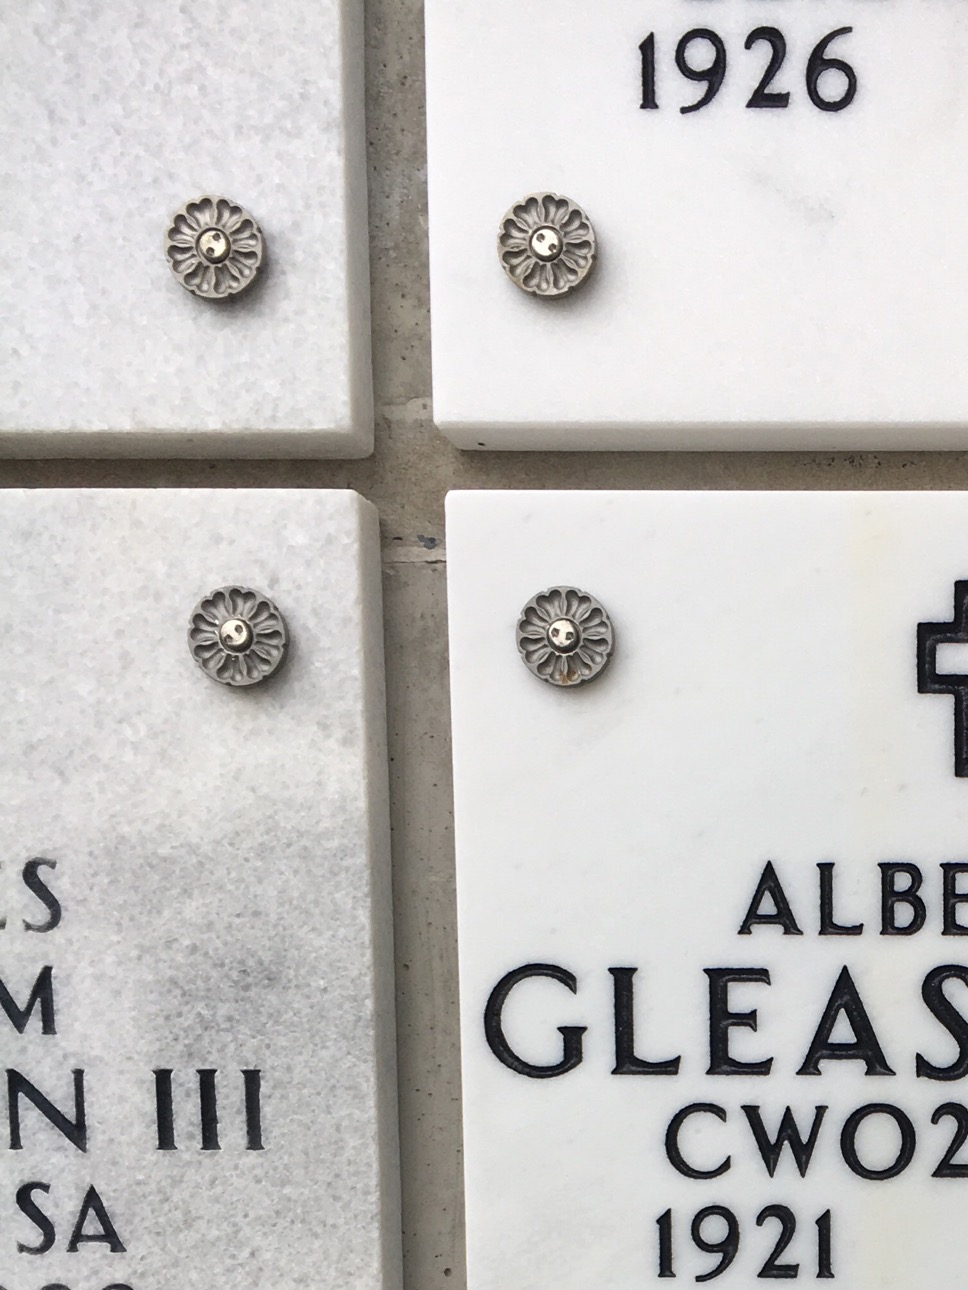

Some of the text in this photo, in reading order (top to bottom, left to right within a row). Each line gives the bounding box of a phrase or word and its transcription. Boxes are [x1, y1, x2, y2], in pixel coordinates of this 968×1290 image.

[637, 25, 857, 115] 1926
[0, 857, 63, 933] S
[4, 1067, 88, 1154] N
[15, 1180, 128, 1256] SA
[655, 1203, 836, 1284] 1921
